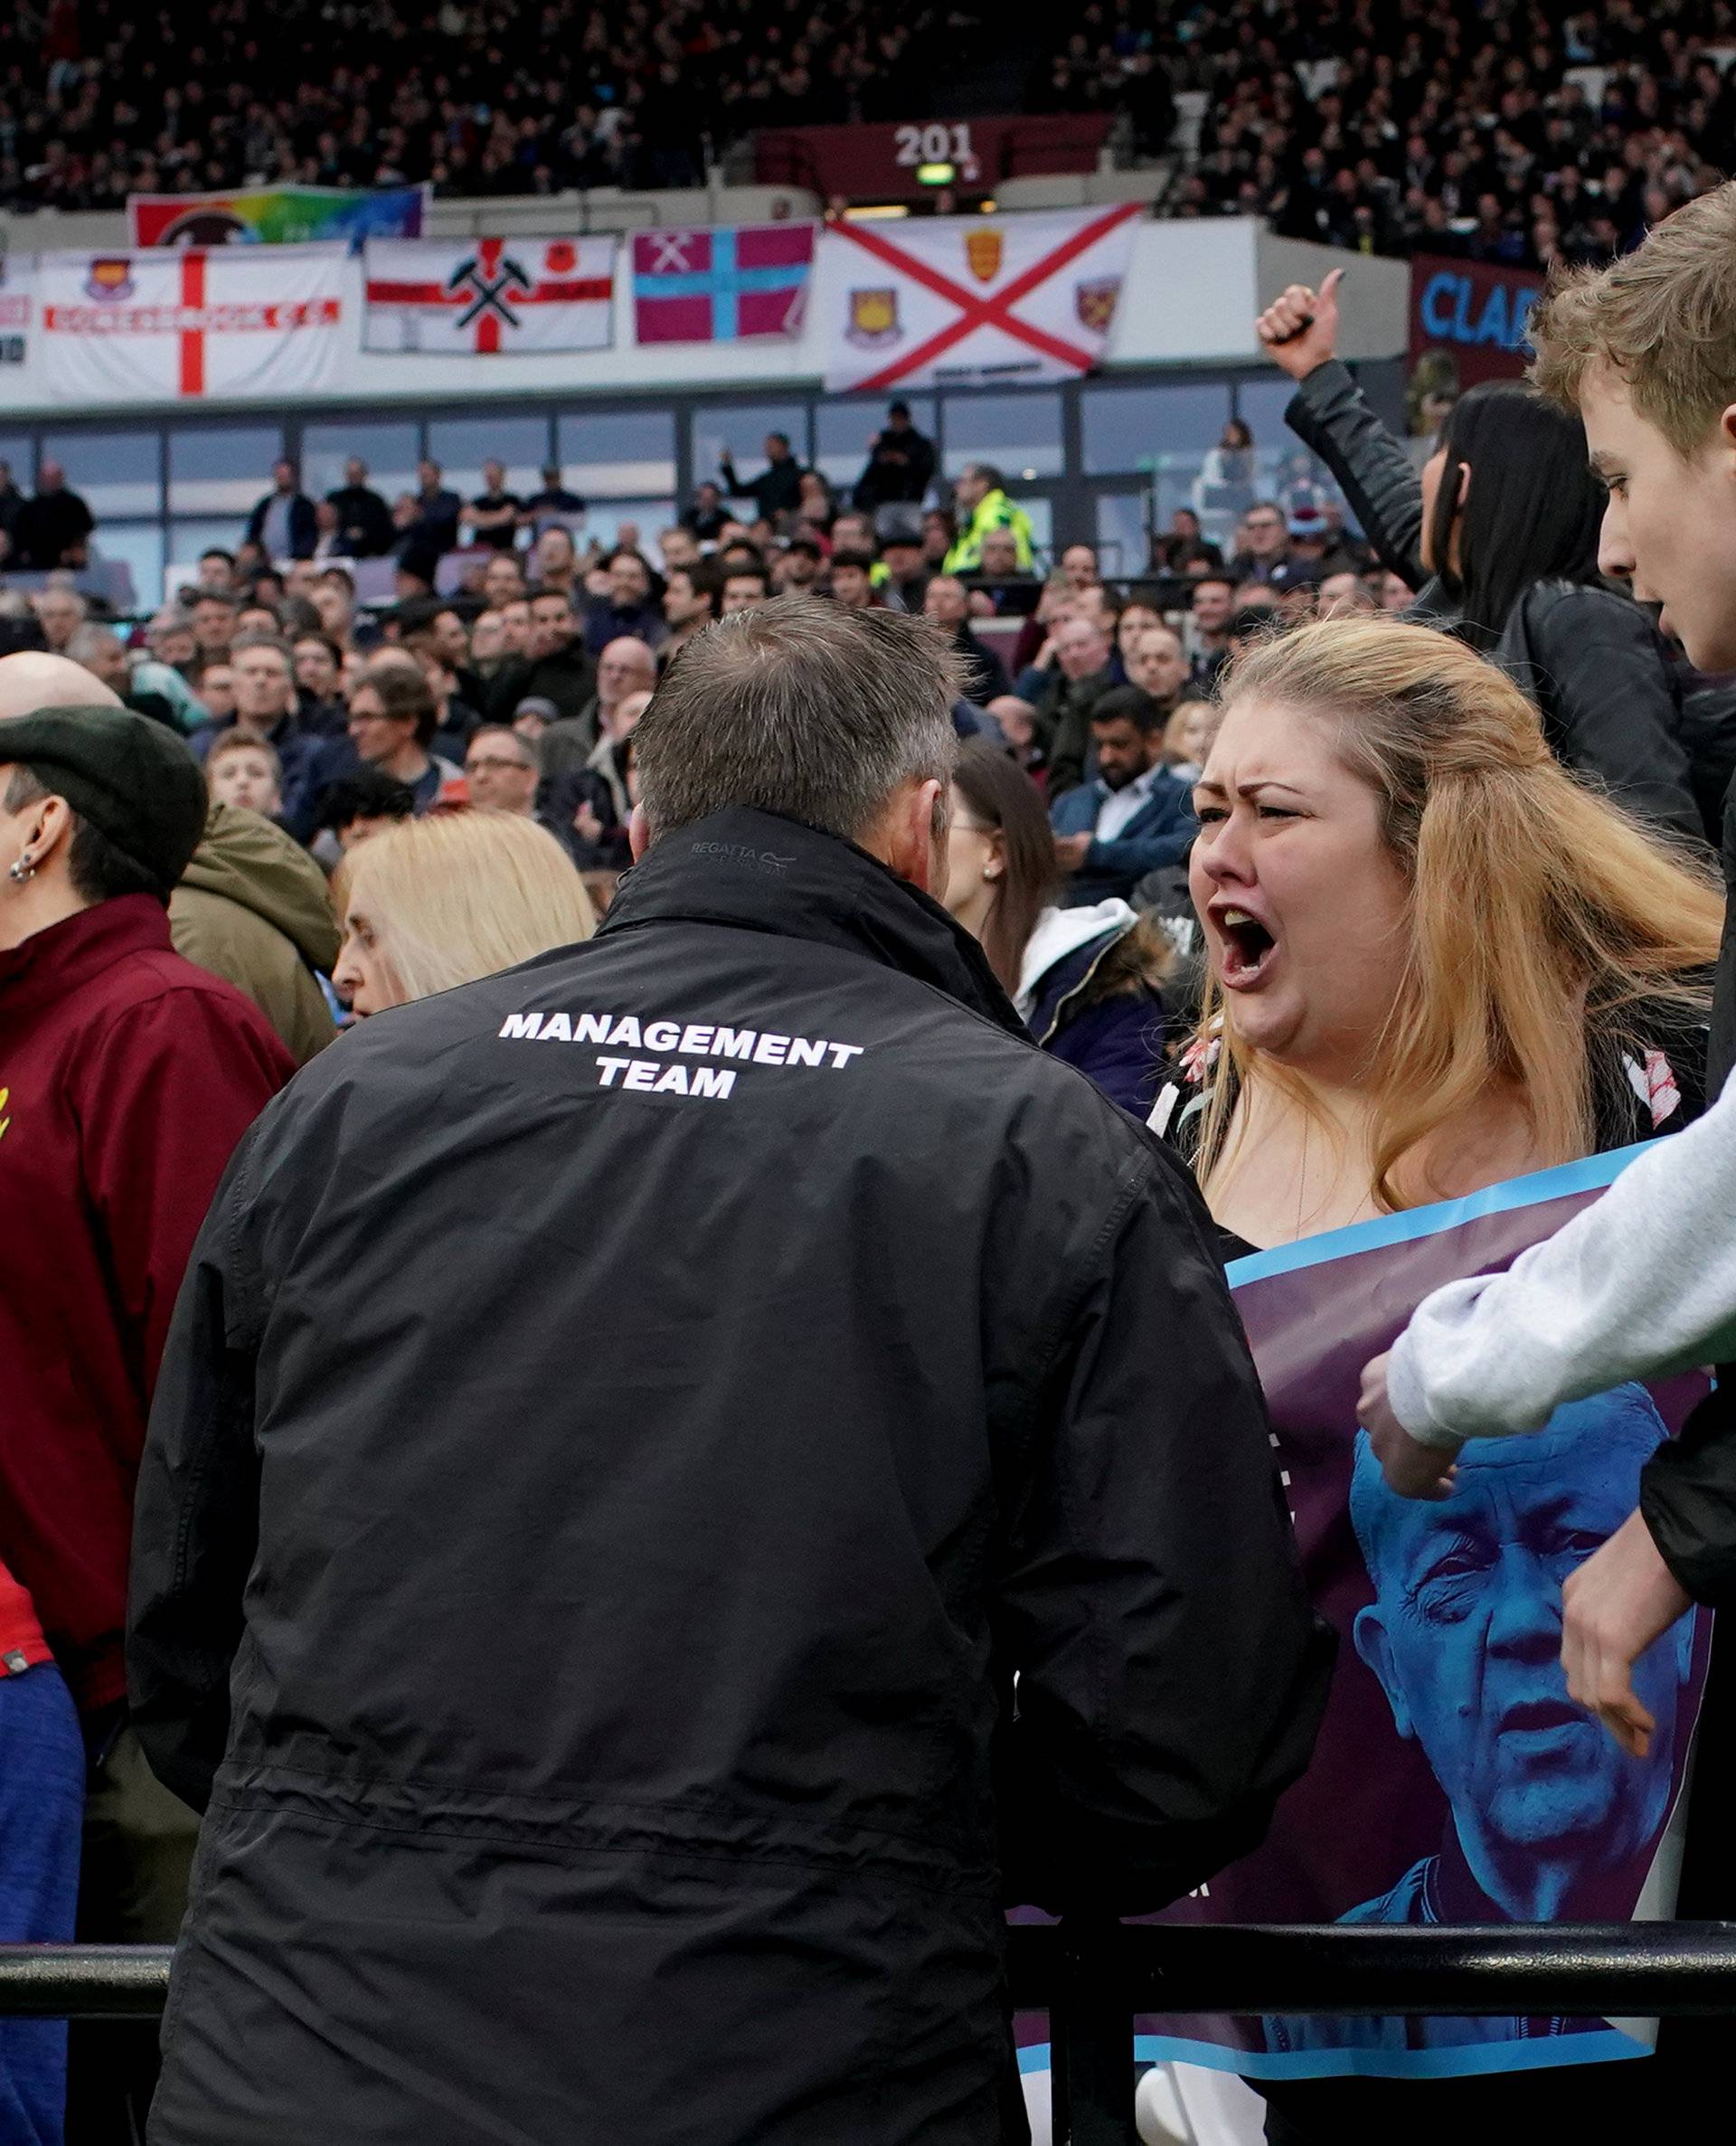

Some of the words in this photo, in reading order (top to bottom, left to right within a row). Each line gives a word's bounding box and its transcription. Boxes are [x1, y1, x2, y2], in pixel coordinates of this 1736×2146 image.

[894, 124, 970, 166] 201
[692, 842, 756, 859] REGATTA
[498, 1012, 864, 1070] MANAGEMENT
[595, 1056, 737, 1100] TEAM
